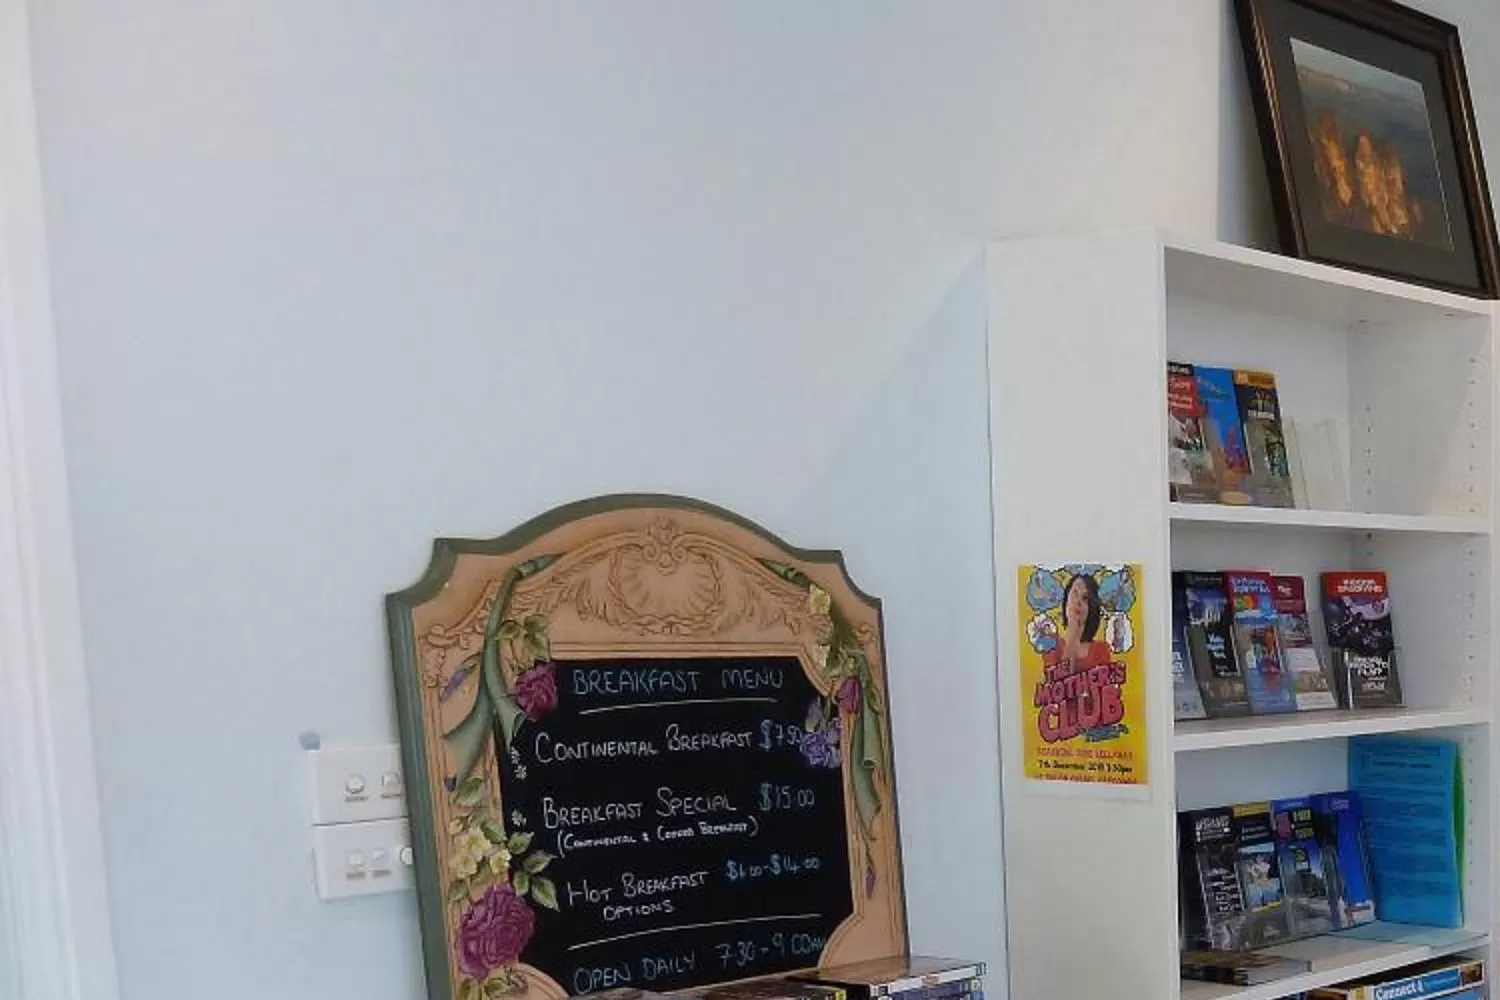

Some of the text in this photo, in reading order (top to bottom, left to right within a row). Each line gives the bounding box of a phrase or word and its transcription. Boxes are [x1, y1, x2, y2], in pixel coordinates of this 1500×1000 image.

[573, 669, 783, 695] BREAKFAST MENU
[1046, 661, 1070, 682] THE
[1038, 684, 1125, 743] CLUB
[535, 732, 659, 763] CONTINENTAL
[666, 723, 752, 752] BREAKFAST
[543, 797, 643, 829] BREAKFAST
[656, 787, 737, 817] SPECIAL
[567, 880, 613, 906] HOT
[621, 871, 710, 897] BREAKFAST
[603, 899, 675, 921] OPTIONS
[573, 963, 631, 996] OPEN
[642, 952, 696, 979] DAILY
[1375, 982, 1416, 1000] Connect
